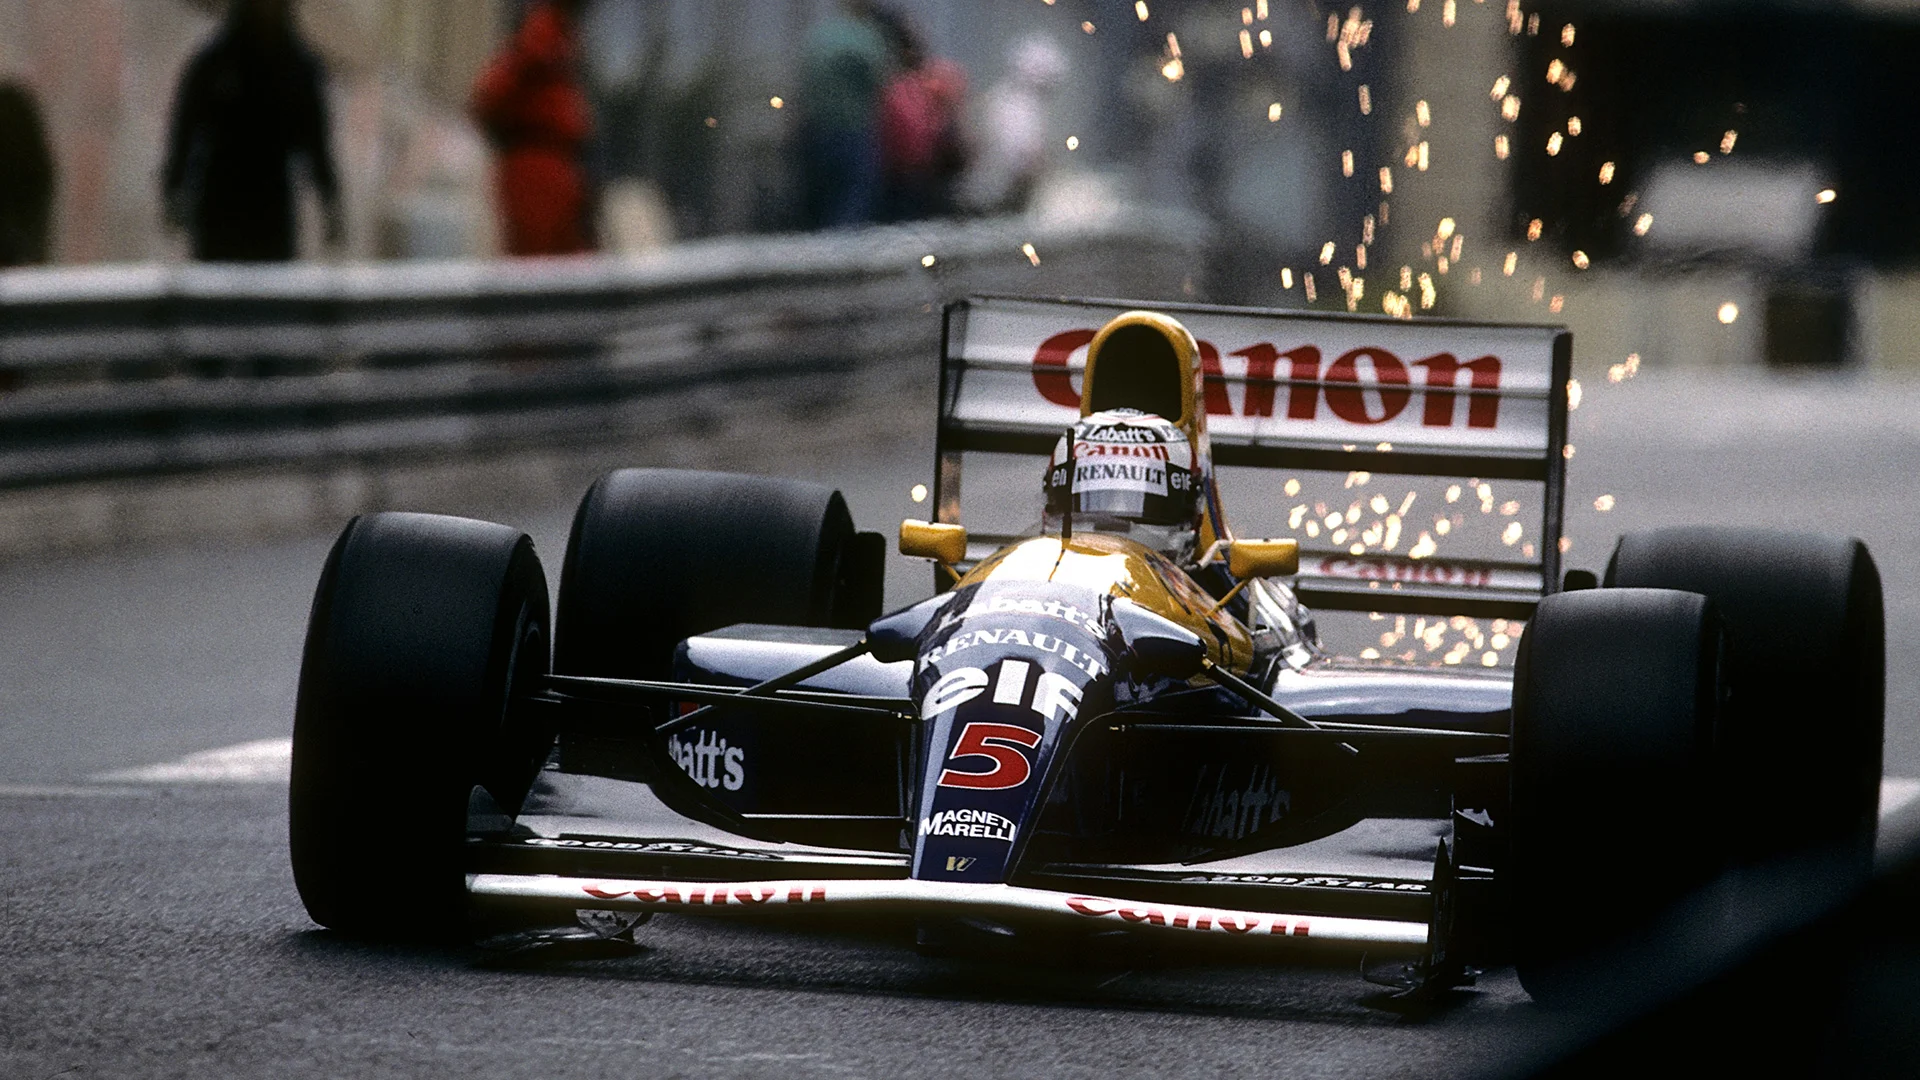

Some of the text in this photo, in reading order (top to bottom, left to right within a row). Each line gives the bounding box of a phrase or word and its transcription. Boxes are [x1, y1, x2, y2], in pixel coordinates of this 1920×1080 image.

[1073, 441, 1171, 461] Canon
[1077, 463, 1167, 486] RENAULT
[1170, 470, 1192, 490] elf
[919, 628, 1110, 682] RENAULT
[921, 658, 1084, 721] elf
[937, 721, 1043, 791] 5
